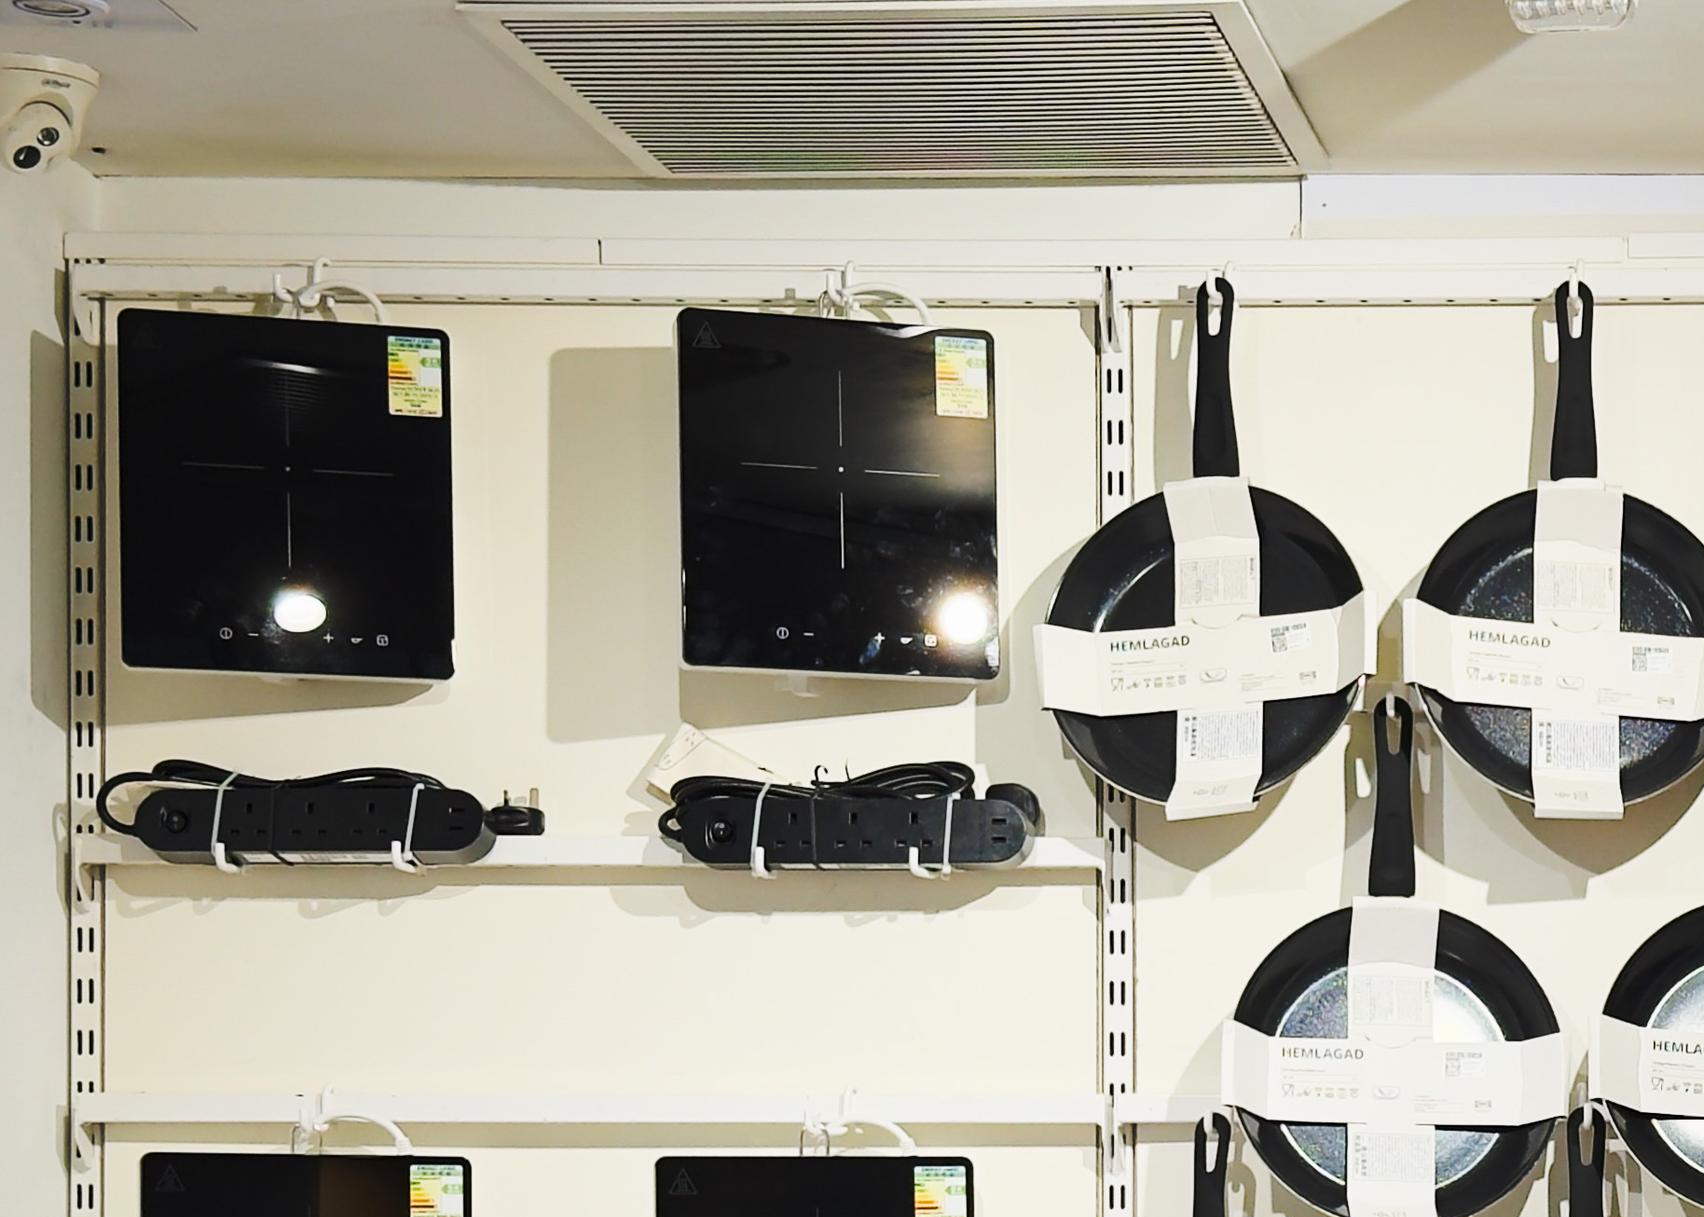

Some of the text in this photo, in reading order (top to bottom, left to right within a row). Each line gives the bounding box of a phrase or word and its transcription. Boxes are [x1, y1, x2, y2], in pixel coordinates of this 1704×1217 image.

[1110, 635, 1191, 652] HEMLAGAD
[1468, 629, 1551, 648] HEMLAGAD
[1281, 1047, 1364, 1060] HEMLAGAD
